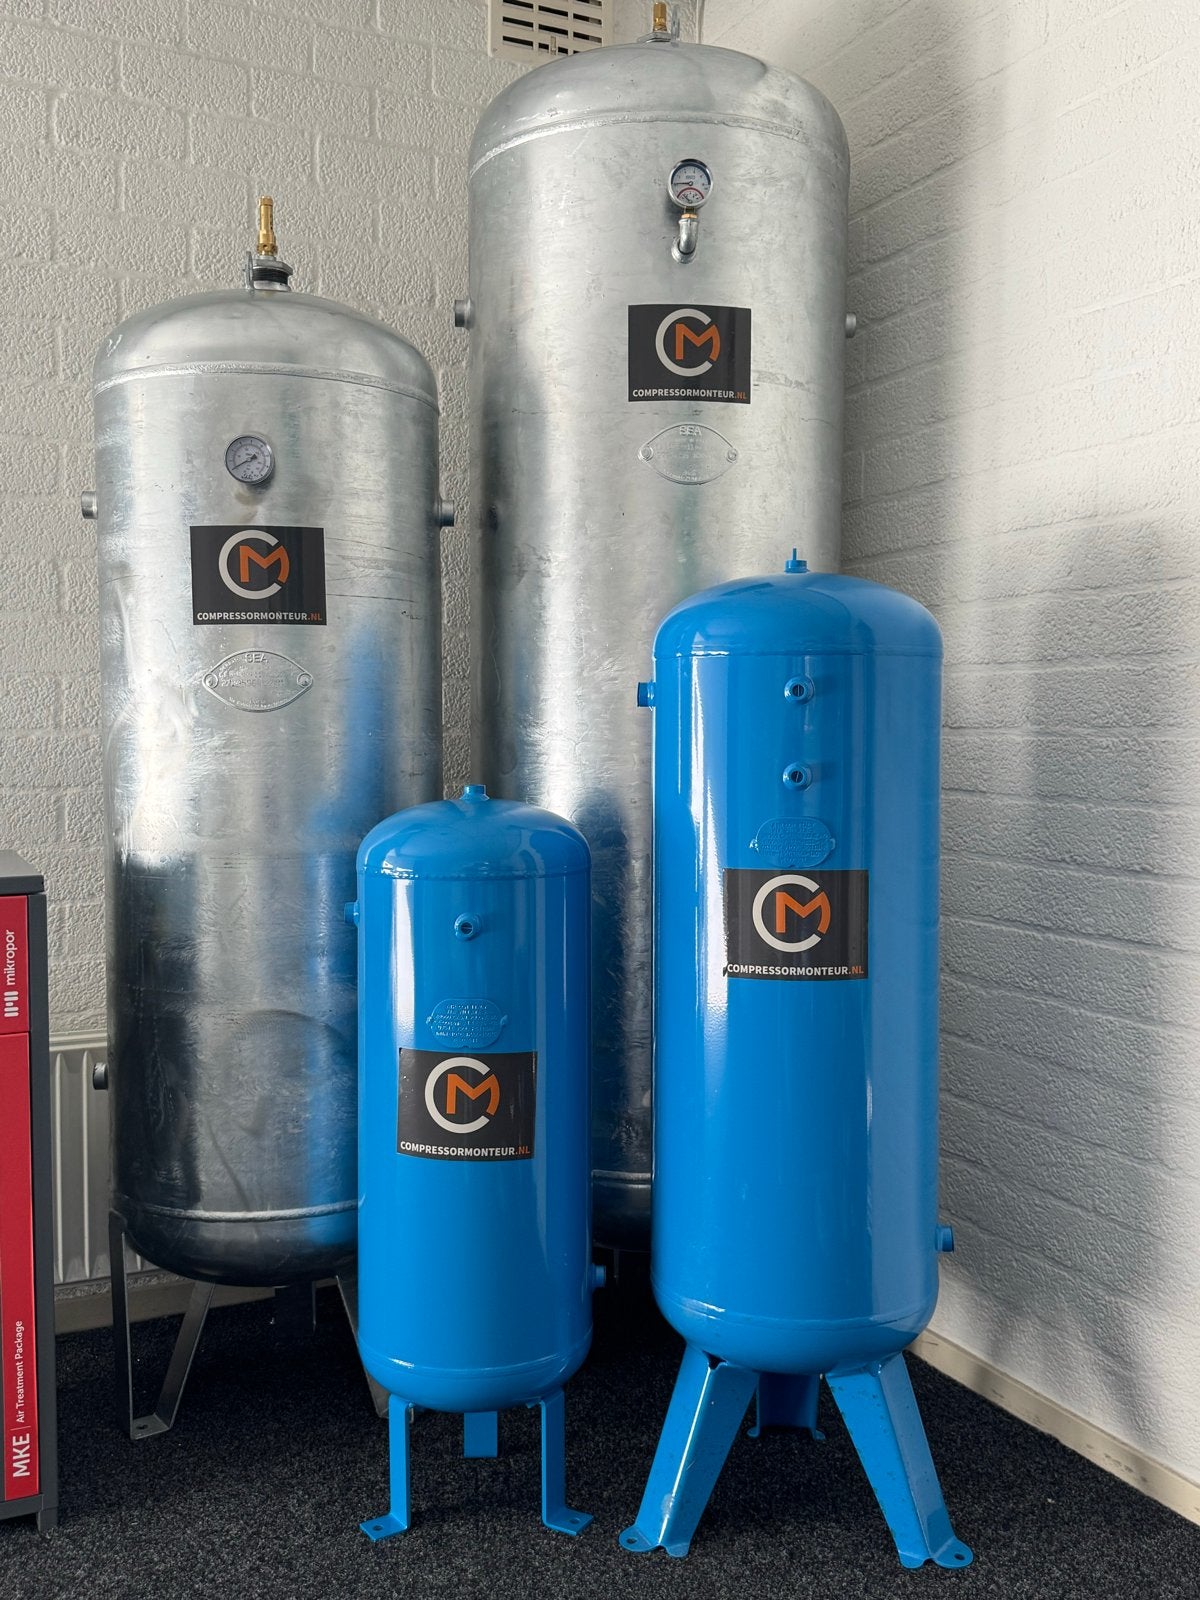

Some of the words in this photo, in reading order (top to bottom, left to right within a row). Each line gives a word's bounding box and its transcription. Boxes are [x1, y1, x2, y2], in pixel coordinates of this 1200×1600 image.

[632, 387, 748, 400] COMPRESSORMONTEUR.NL
[196, 610, 323, 623] COMPRESSORMONTEUR.NL
[4, 929, 18, 986] mikropor
[727, 963, 864, 976] COMPRESSORMONTEUR.NL
[400, 1141, 530, 1158] COMPRESSORMONTEUR.NL
[14, 1320, 25, 1360] Package
[15, 1361, 24, 1409] Treatment
[16, 1409, 24, 1423] Air
[12, 1432, 31, 1478] MKE
